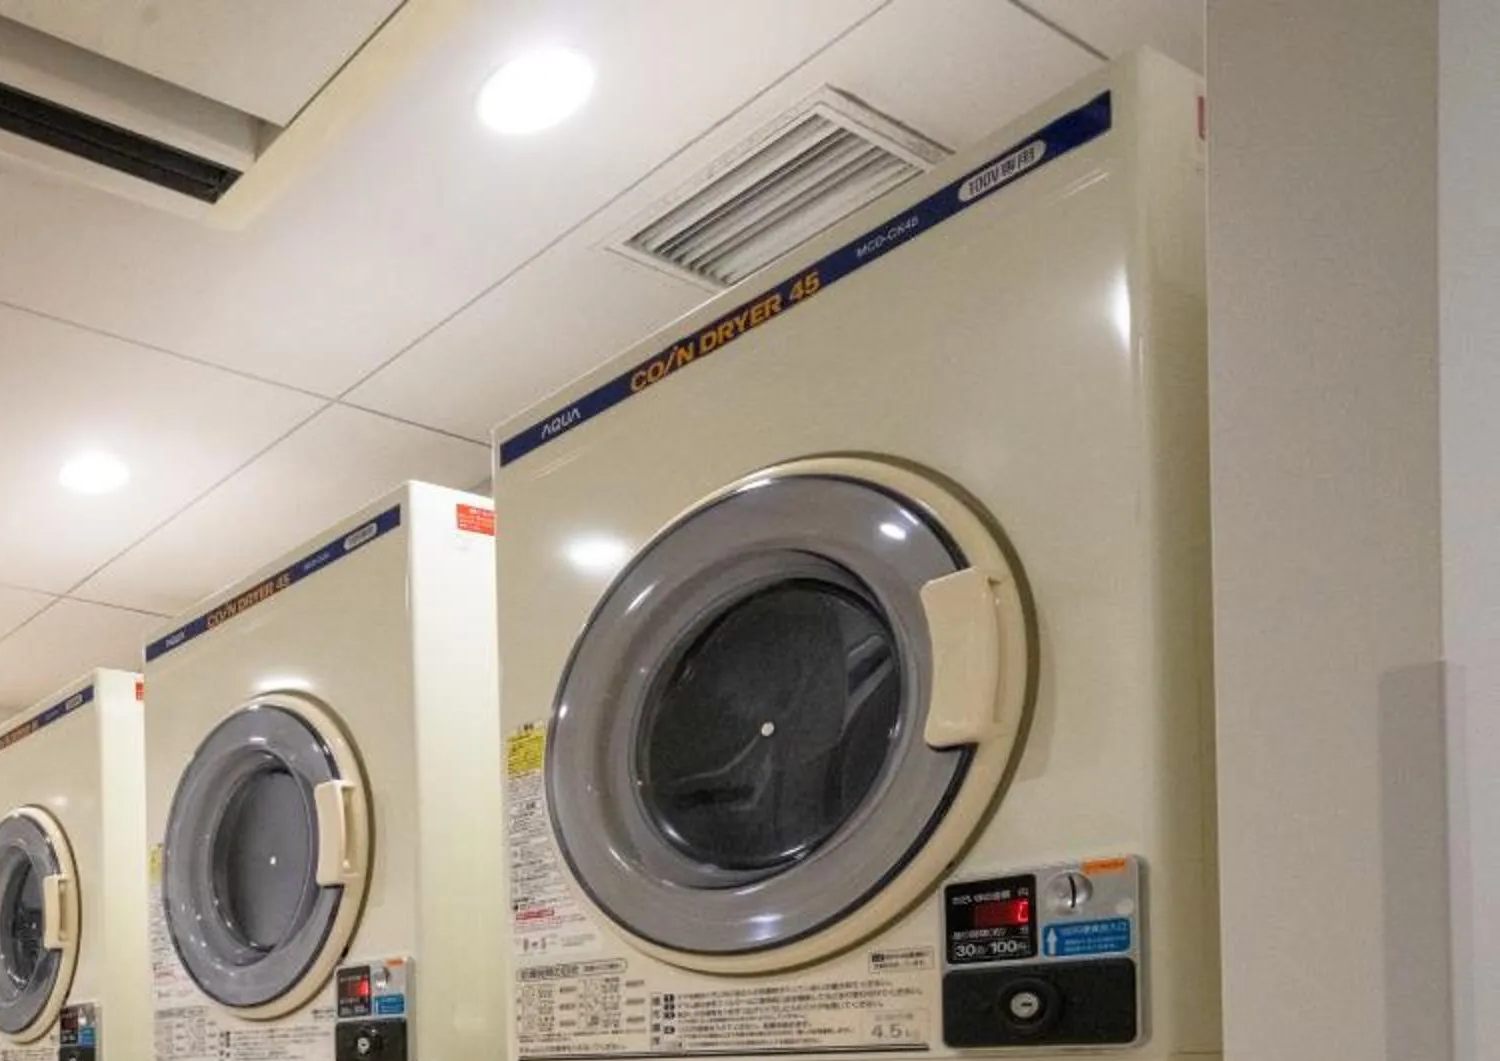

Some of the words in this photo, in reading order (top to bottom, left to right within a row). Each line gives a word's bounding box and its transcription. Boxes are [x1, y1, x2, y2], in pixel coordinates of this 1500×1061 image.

[698, 294, 783, 355] DRYER
[788, 271, 821, 301] 45
[540, 406, 581, 439] AQUA
